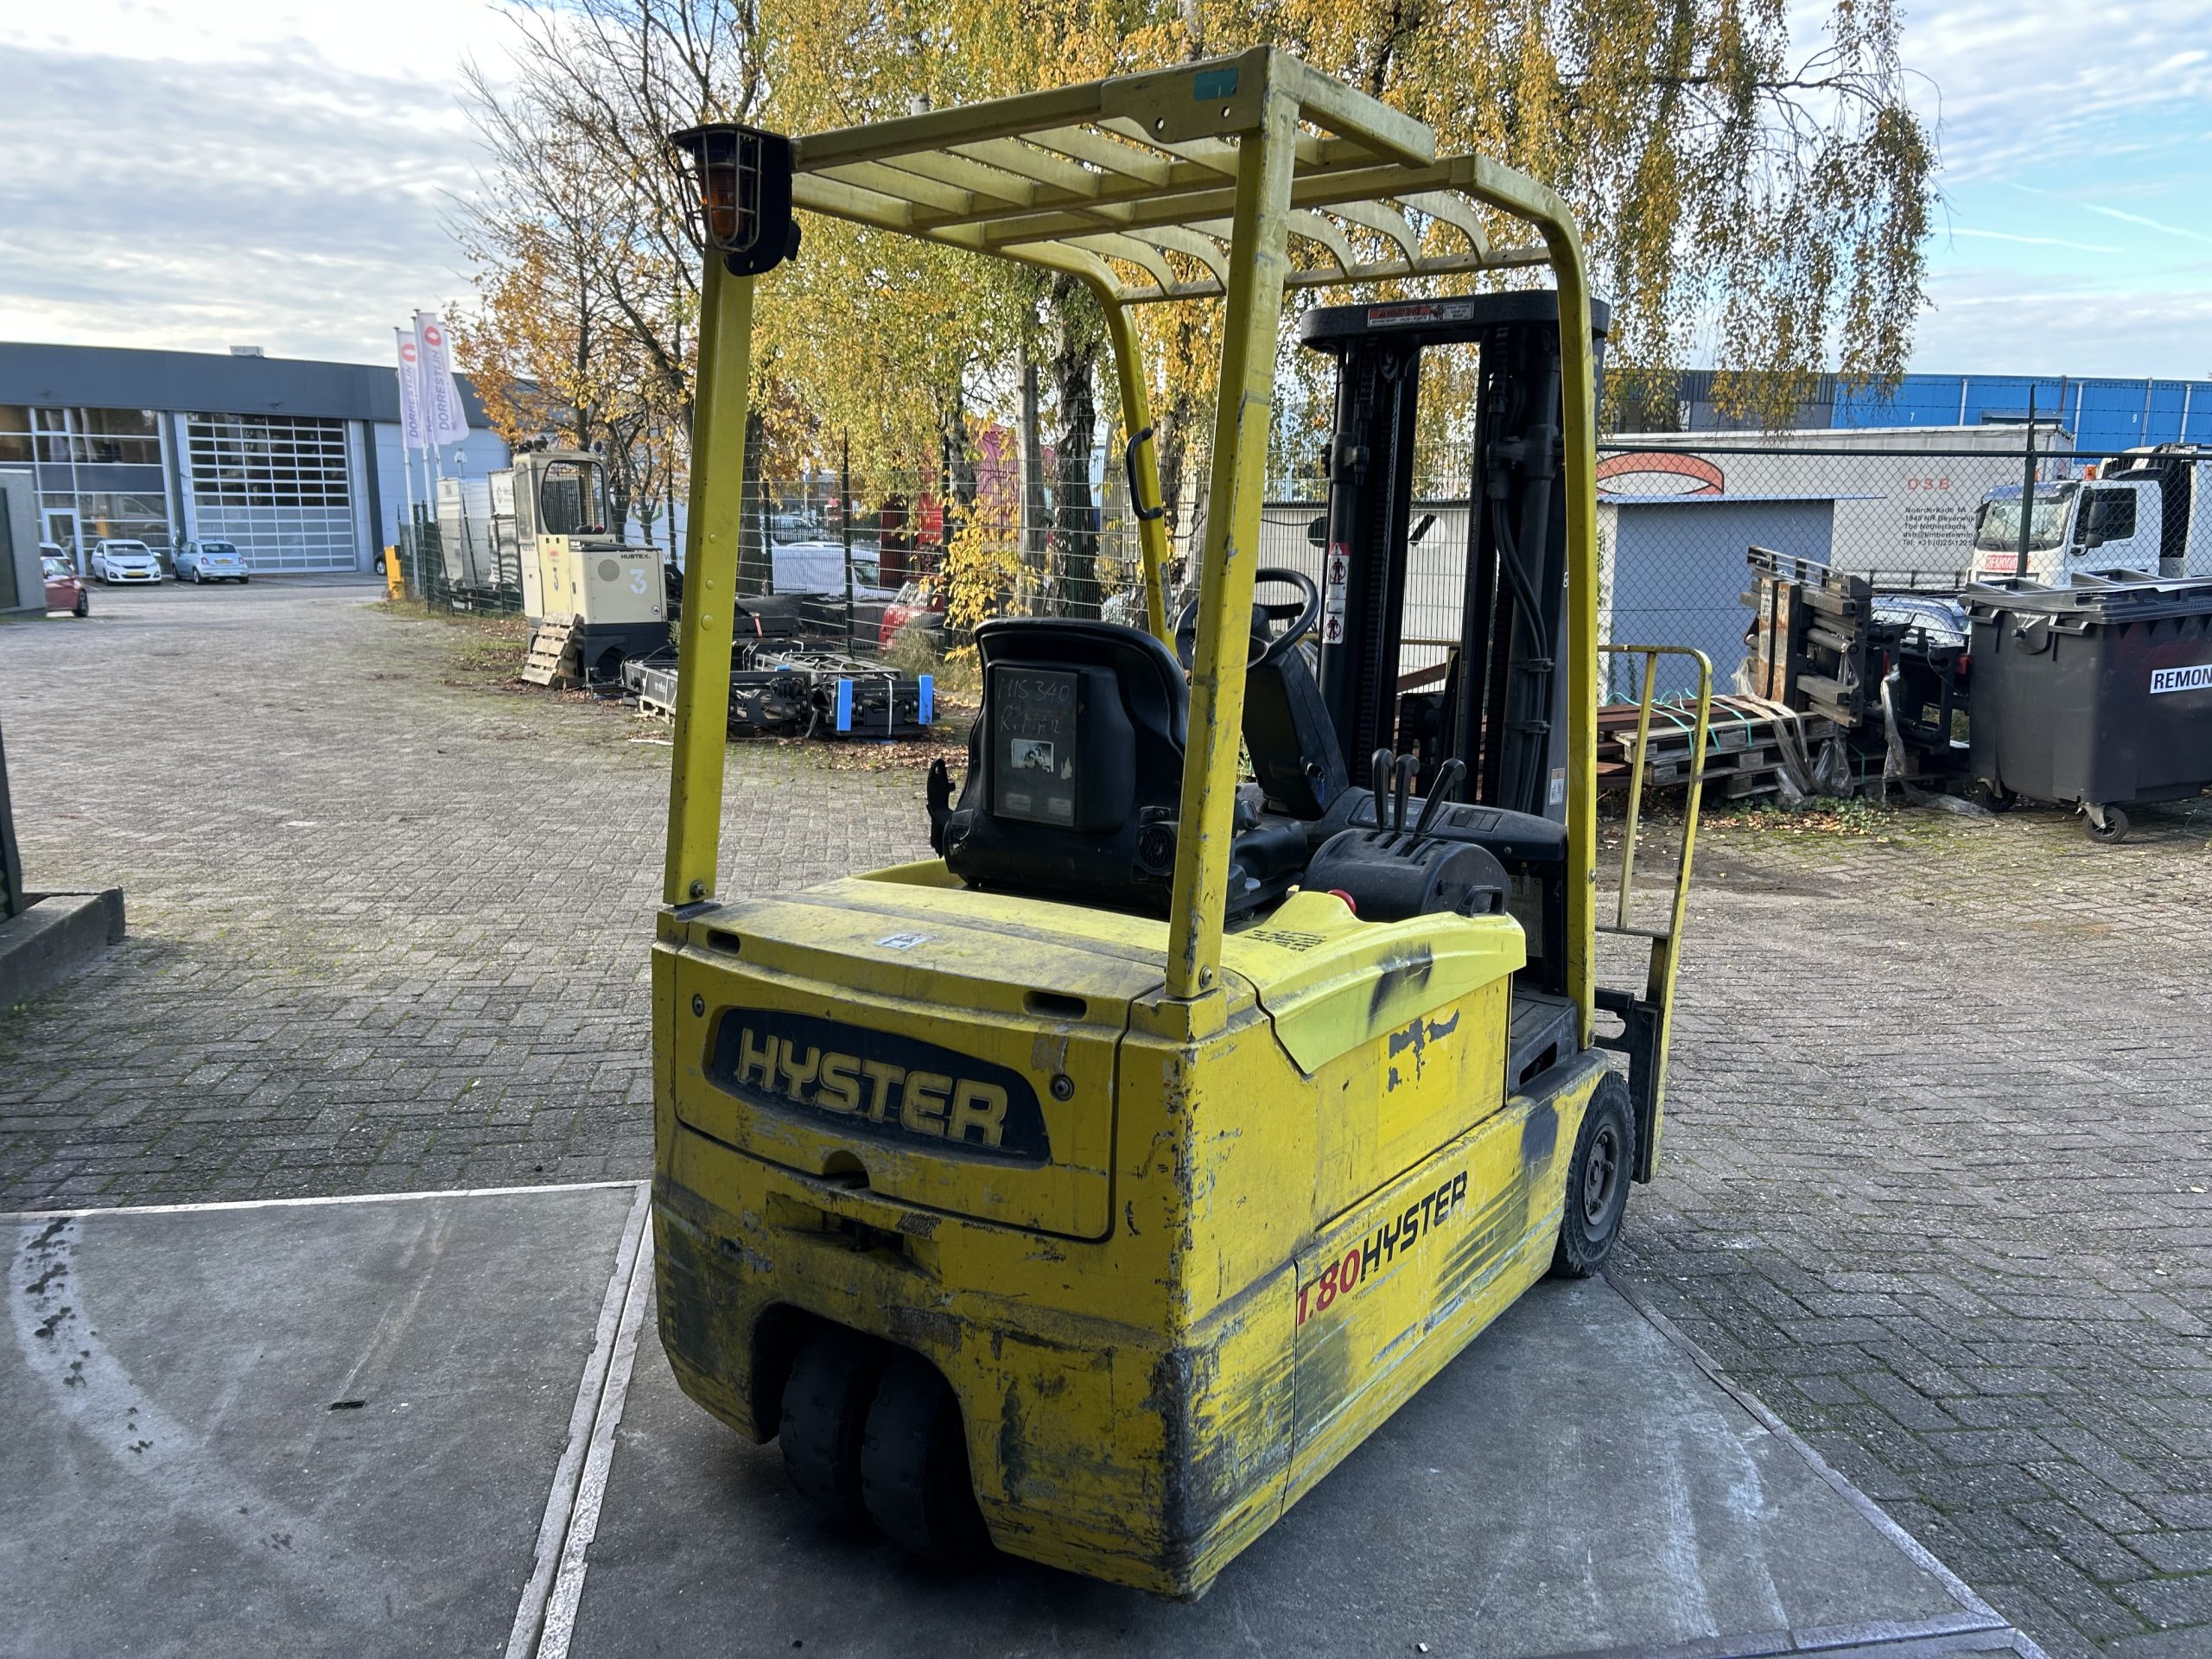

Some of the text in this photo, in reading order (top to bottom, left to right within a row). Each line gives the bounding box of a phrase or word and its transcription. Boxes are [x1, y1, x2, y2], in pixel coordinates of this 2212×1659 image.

[1910, 412, 1915, 422] 7
[2132, 413, 2138, 423] 9
[629, 568, 648, 595] 3
[737, 1027, 1008, 1148] HYSTER
[1360, 1170, 1468, 1284] HYSTER
